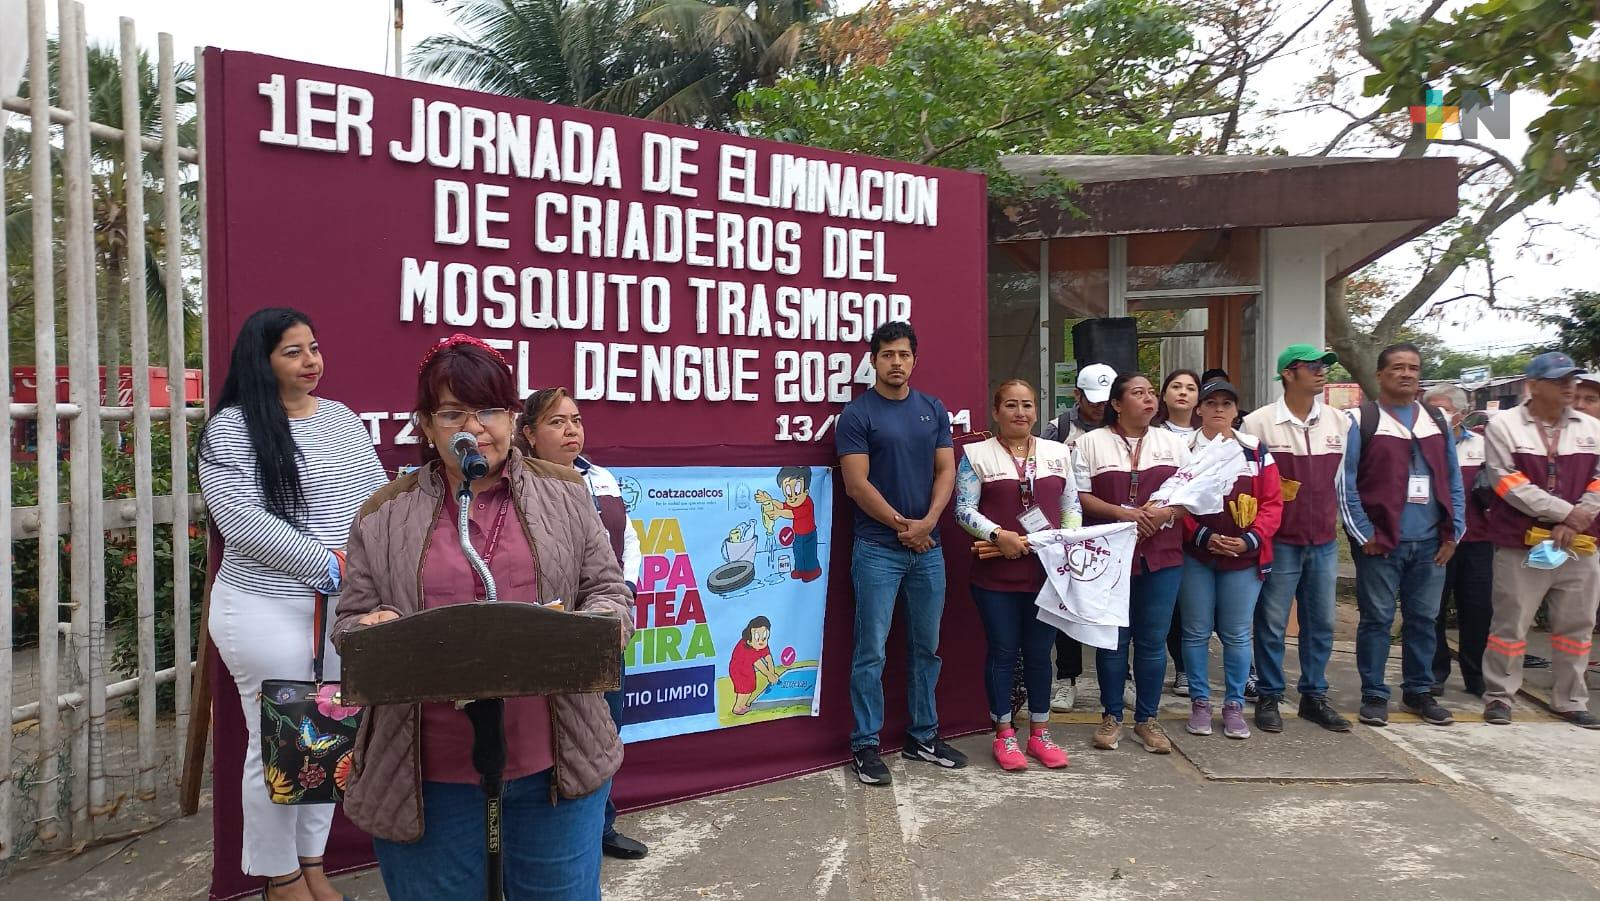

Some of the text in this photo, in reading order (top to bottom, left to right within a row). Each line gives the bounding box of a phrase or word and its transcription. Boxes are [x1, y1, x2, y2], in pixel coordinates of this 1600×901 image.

[258, 73, 939, 227] 1ER JORNADA DE ELIMINACION
[434, 178, 897, 283] DE CRIADEROS DEL
[400, 256, 912, 344] MOSQUITO TRASMISOR
[573, 341, 760, 403] DENGUE
[774, 350, 877, 403] 2024
[647, 488, 723, 499] Coatzacoalcos
[623, 624, 717, 667] TIRA
[622, 683, 709, 708] TIO LIMPIO
